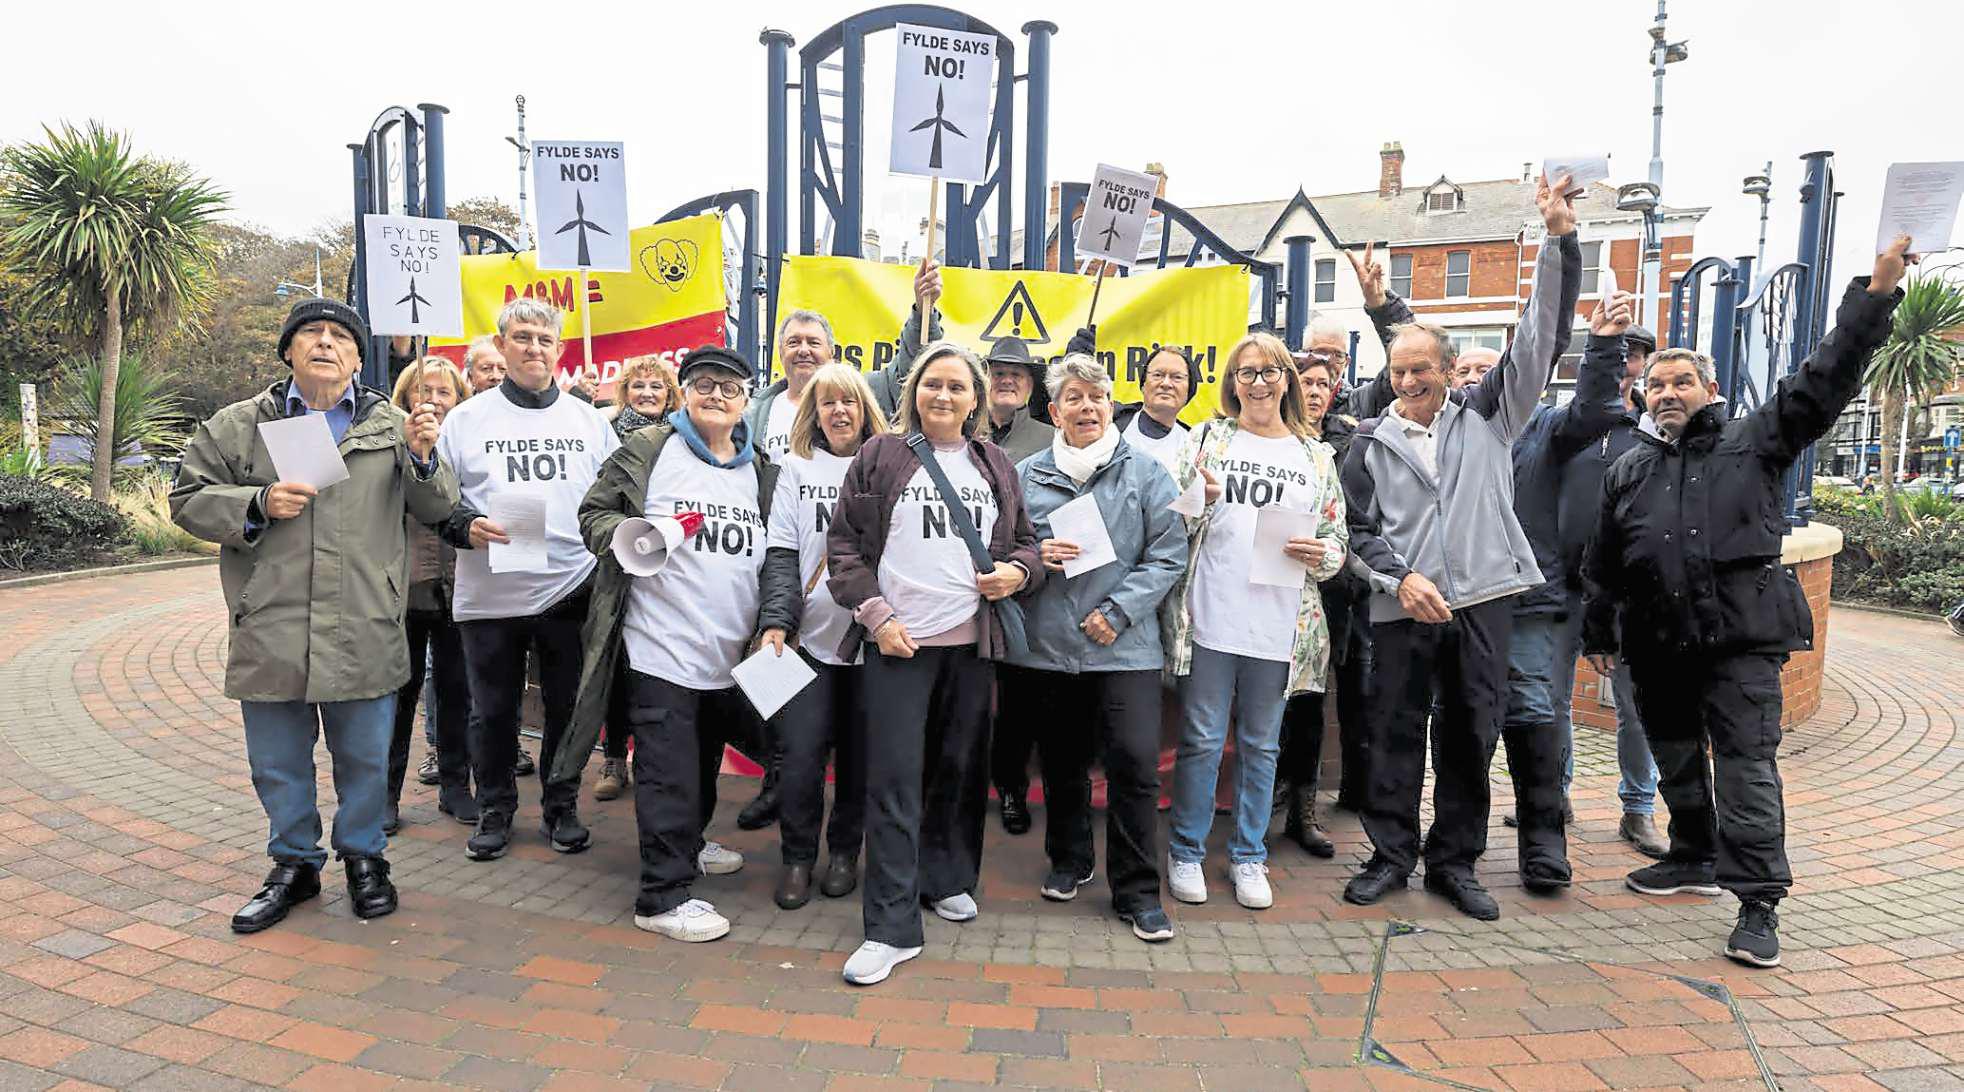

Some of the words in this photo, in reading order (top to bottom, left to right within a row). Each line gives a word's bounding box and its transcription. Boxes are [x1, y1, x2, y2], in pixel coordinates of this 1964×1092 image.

[903, 32, 949, 51] FYLDE
[953, 38, 990, 56] SAYS
[924, 55, 966, 80] NO!
[537, 146, 580, 158] FYLDE
[584, 147, 620, 159] SAYS
[560, 163, 599, 182] NO!
[1098, 179, 1127, 194] FYLDE
[1127, 186, 1151, 200] SAYS
[1103, 191, 1137, 215] NO!
[383, 226, 440, 242] FYLDE
[390, 243, 438, 260] SAYS
[400, 259, 430, 274] NO!
[485, 439, 539, 454] FYLDE
[544, 438, 585, 452] SAYS
[506, 453, 567, 483] NO!
[1220, 459, 1262, 476] YLDE
[1266, 465, 1307, 486] SAYS
[800, 485, 842, 501] FYLD
[901, 486, 945, 502] FYLD
[695, 520, 753, 557] NO!
